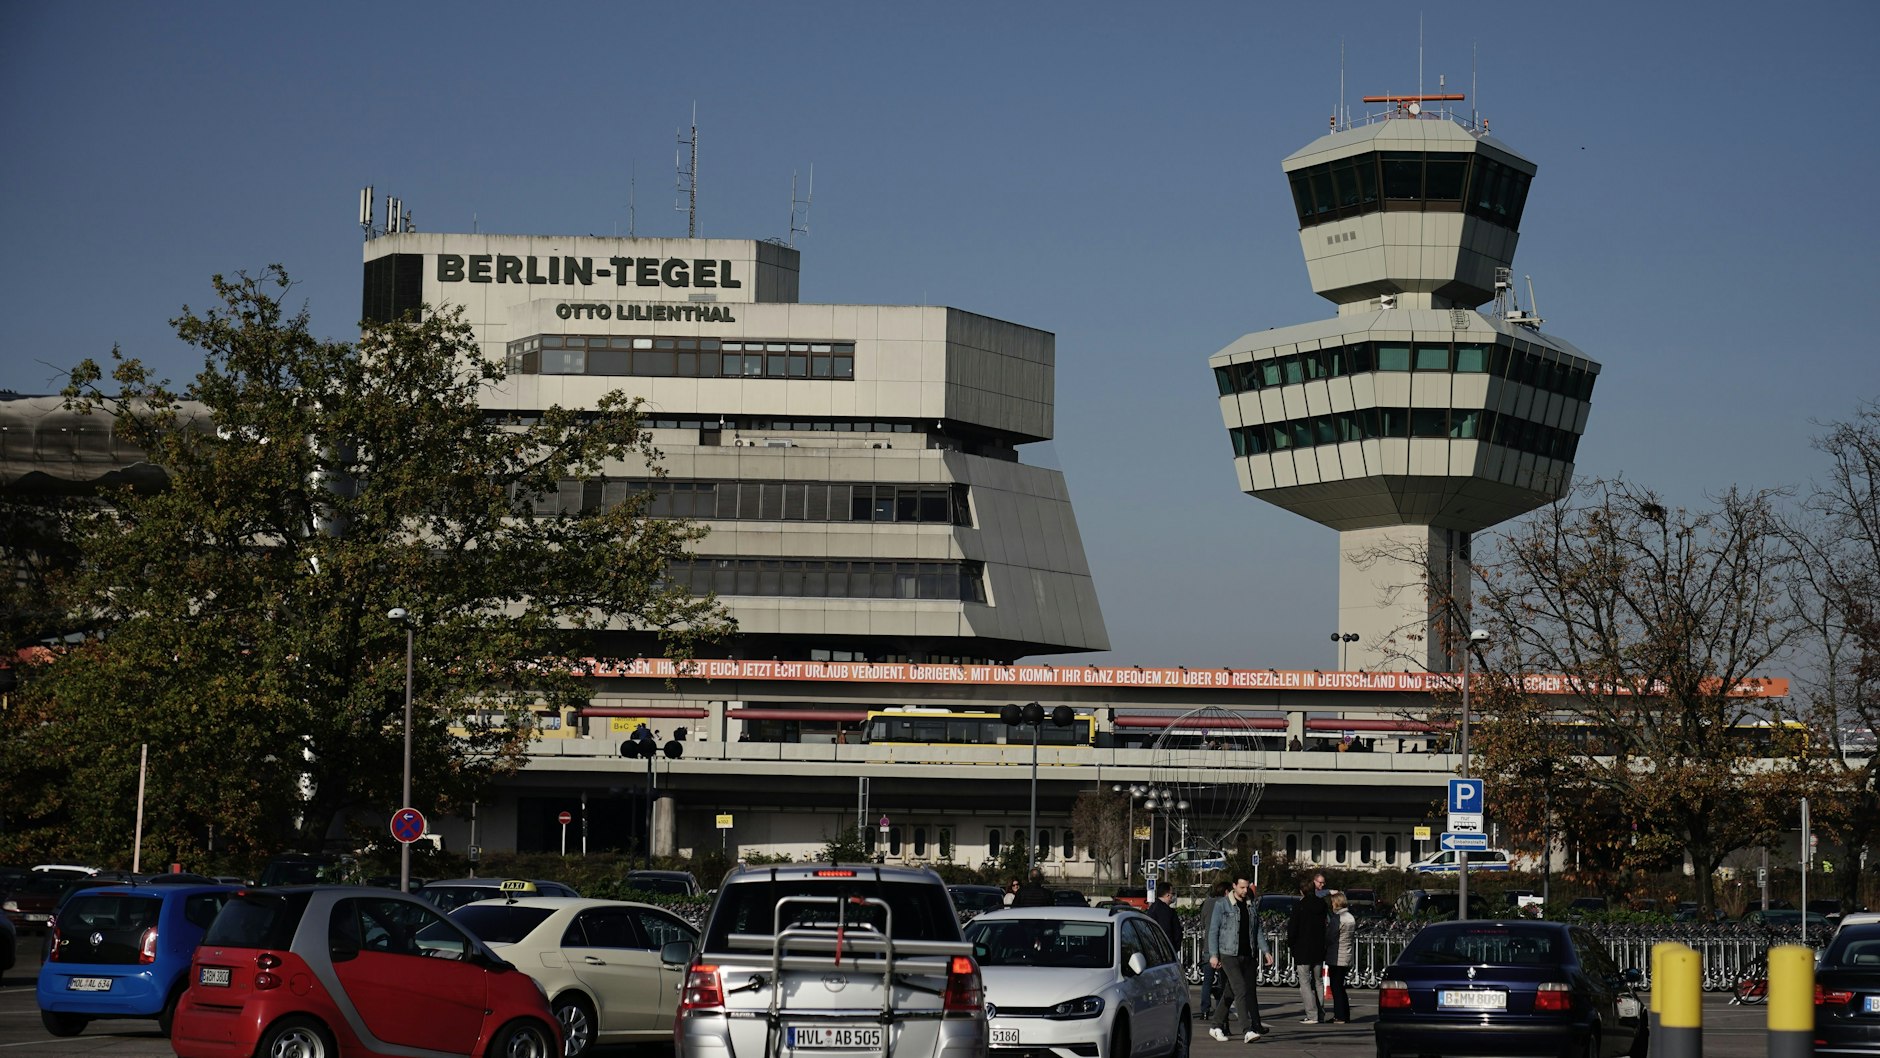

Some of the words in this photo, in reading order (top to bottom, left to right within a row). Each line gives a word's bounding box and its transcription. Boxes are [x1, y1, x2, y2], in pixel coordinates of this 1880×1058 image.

[437, 254, 741, 289] BERLIN-TEGEL
[556, 303, 611, 320] OTTO
[616, 305, 735, 322] LILIENTHAL
[657, 661, 676, 675] IHR
[710, 662, 739, 676] EUCH
[742, 662, 772, 677] JETZT
[775, 663, 802, 678] ECHT
[805, 664, 848, 679] URLAUB
[851, 665, 906, 680] VERDIENT.
[910, 665, 968, 681] ÜBRIGENS:
[971, 667, 990, 681] MIT
[994, 668, 1016, 682] UNS
[1019, 668, 1059, 682] KOMMT
[1062, 669, 1081, 683] IHR
[1084, 669, 1112, 683] GANZ
[1116, 670, 1161, 684] BEQUEM
[1165, 671, 1179, 685] ZU
[1215, 672, 1229, 686] 90
[1233, 672, 1299, 687] REISEZIELEN
[1303, 673, 1315, 687] IN
[1318, 673, 1395, 688] DEUTSCHLAND
[1399, 675, 1422, 689] UND
[1456, 783, 1476, 810] P
[470, 847, 478, 859] P
[1147, 861, 1156, 874] P
[1759, 868, 1767, 881] P
[88, 979, 96, 988] AL
[1445, 992, 1453, 1004] B
[1460, 993, 1475, 1004] MW
[1477, 993, 1505, 1005] 8090
[797, 1029, 823, 1045] HVL
[835, 1030, 852, 1045] AB
[854, 1030, 880, 1046] 505
[992, 1030, 1017, 1042] 5186
